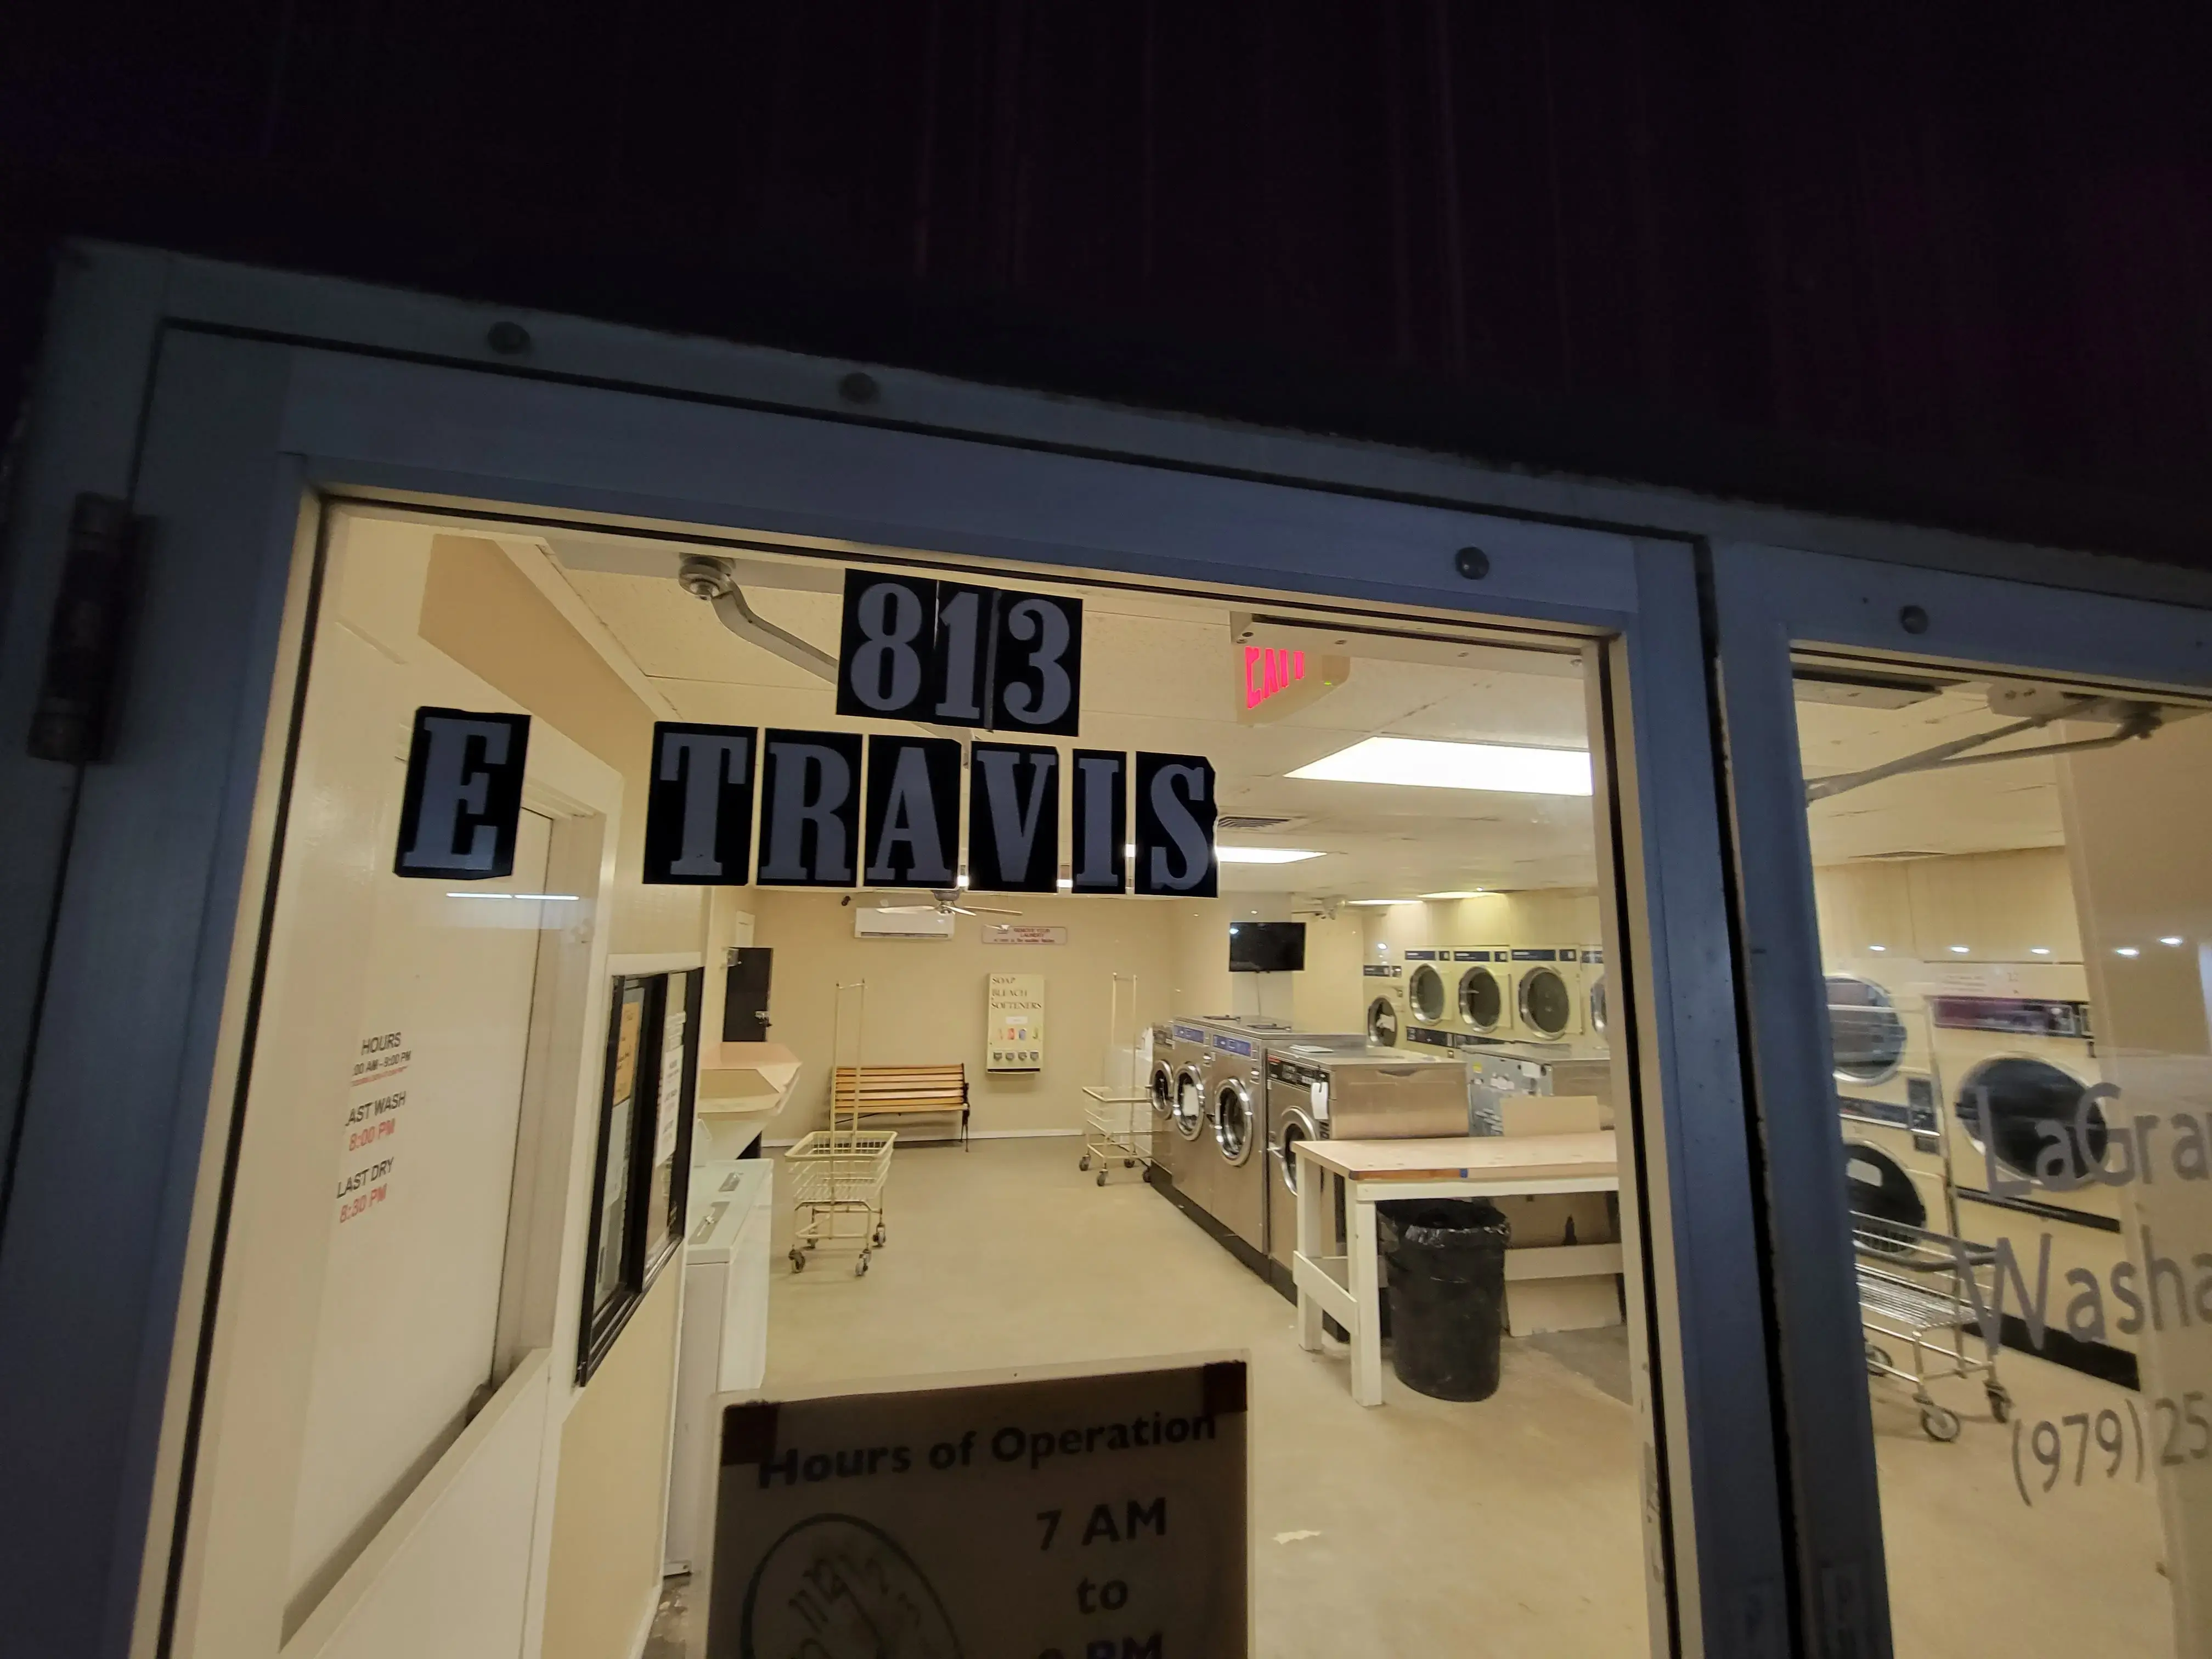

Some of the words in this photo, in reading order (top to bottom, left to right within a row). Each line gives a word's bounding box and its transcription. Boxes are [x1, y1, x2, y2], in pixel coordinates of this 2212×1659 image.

[849, 582, 1074, 725] 813
[403, 716, 512, 871] E
[658, 732, 1210, 890] TRAVIS
[361, 1031, 402, 1056] HOURS
[400, 1050, 412, 1063] PM
[374, 1091, 407, 1116] WASH
[349, 1126, 375, 1151] 8:00
[378, 1118, 396, 1140] PM
[1977, 1082, 2212, 1198] LaGra
[336, 1168, 370, 1199] LAST
[370, 1156, 394, 1182] DRY
[340, 1194, 367, 1223] 8:30
[368, 1182, 387, 1207] PM
[758, 1444, 911, 1489] Hours
[928, 1430, 975, 1471] of
[991, 1412, 1217, 1470] Operation
[2012, 1398, 2144, 1506] (979)
[1036, 1509, 1063, 1551] 7
[1081, 1497, 1167, 1547] AM
[1077, 1575, 1128, 1615] to
